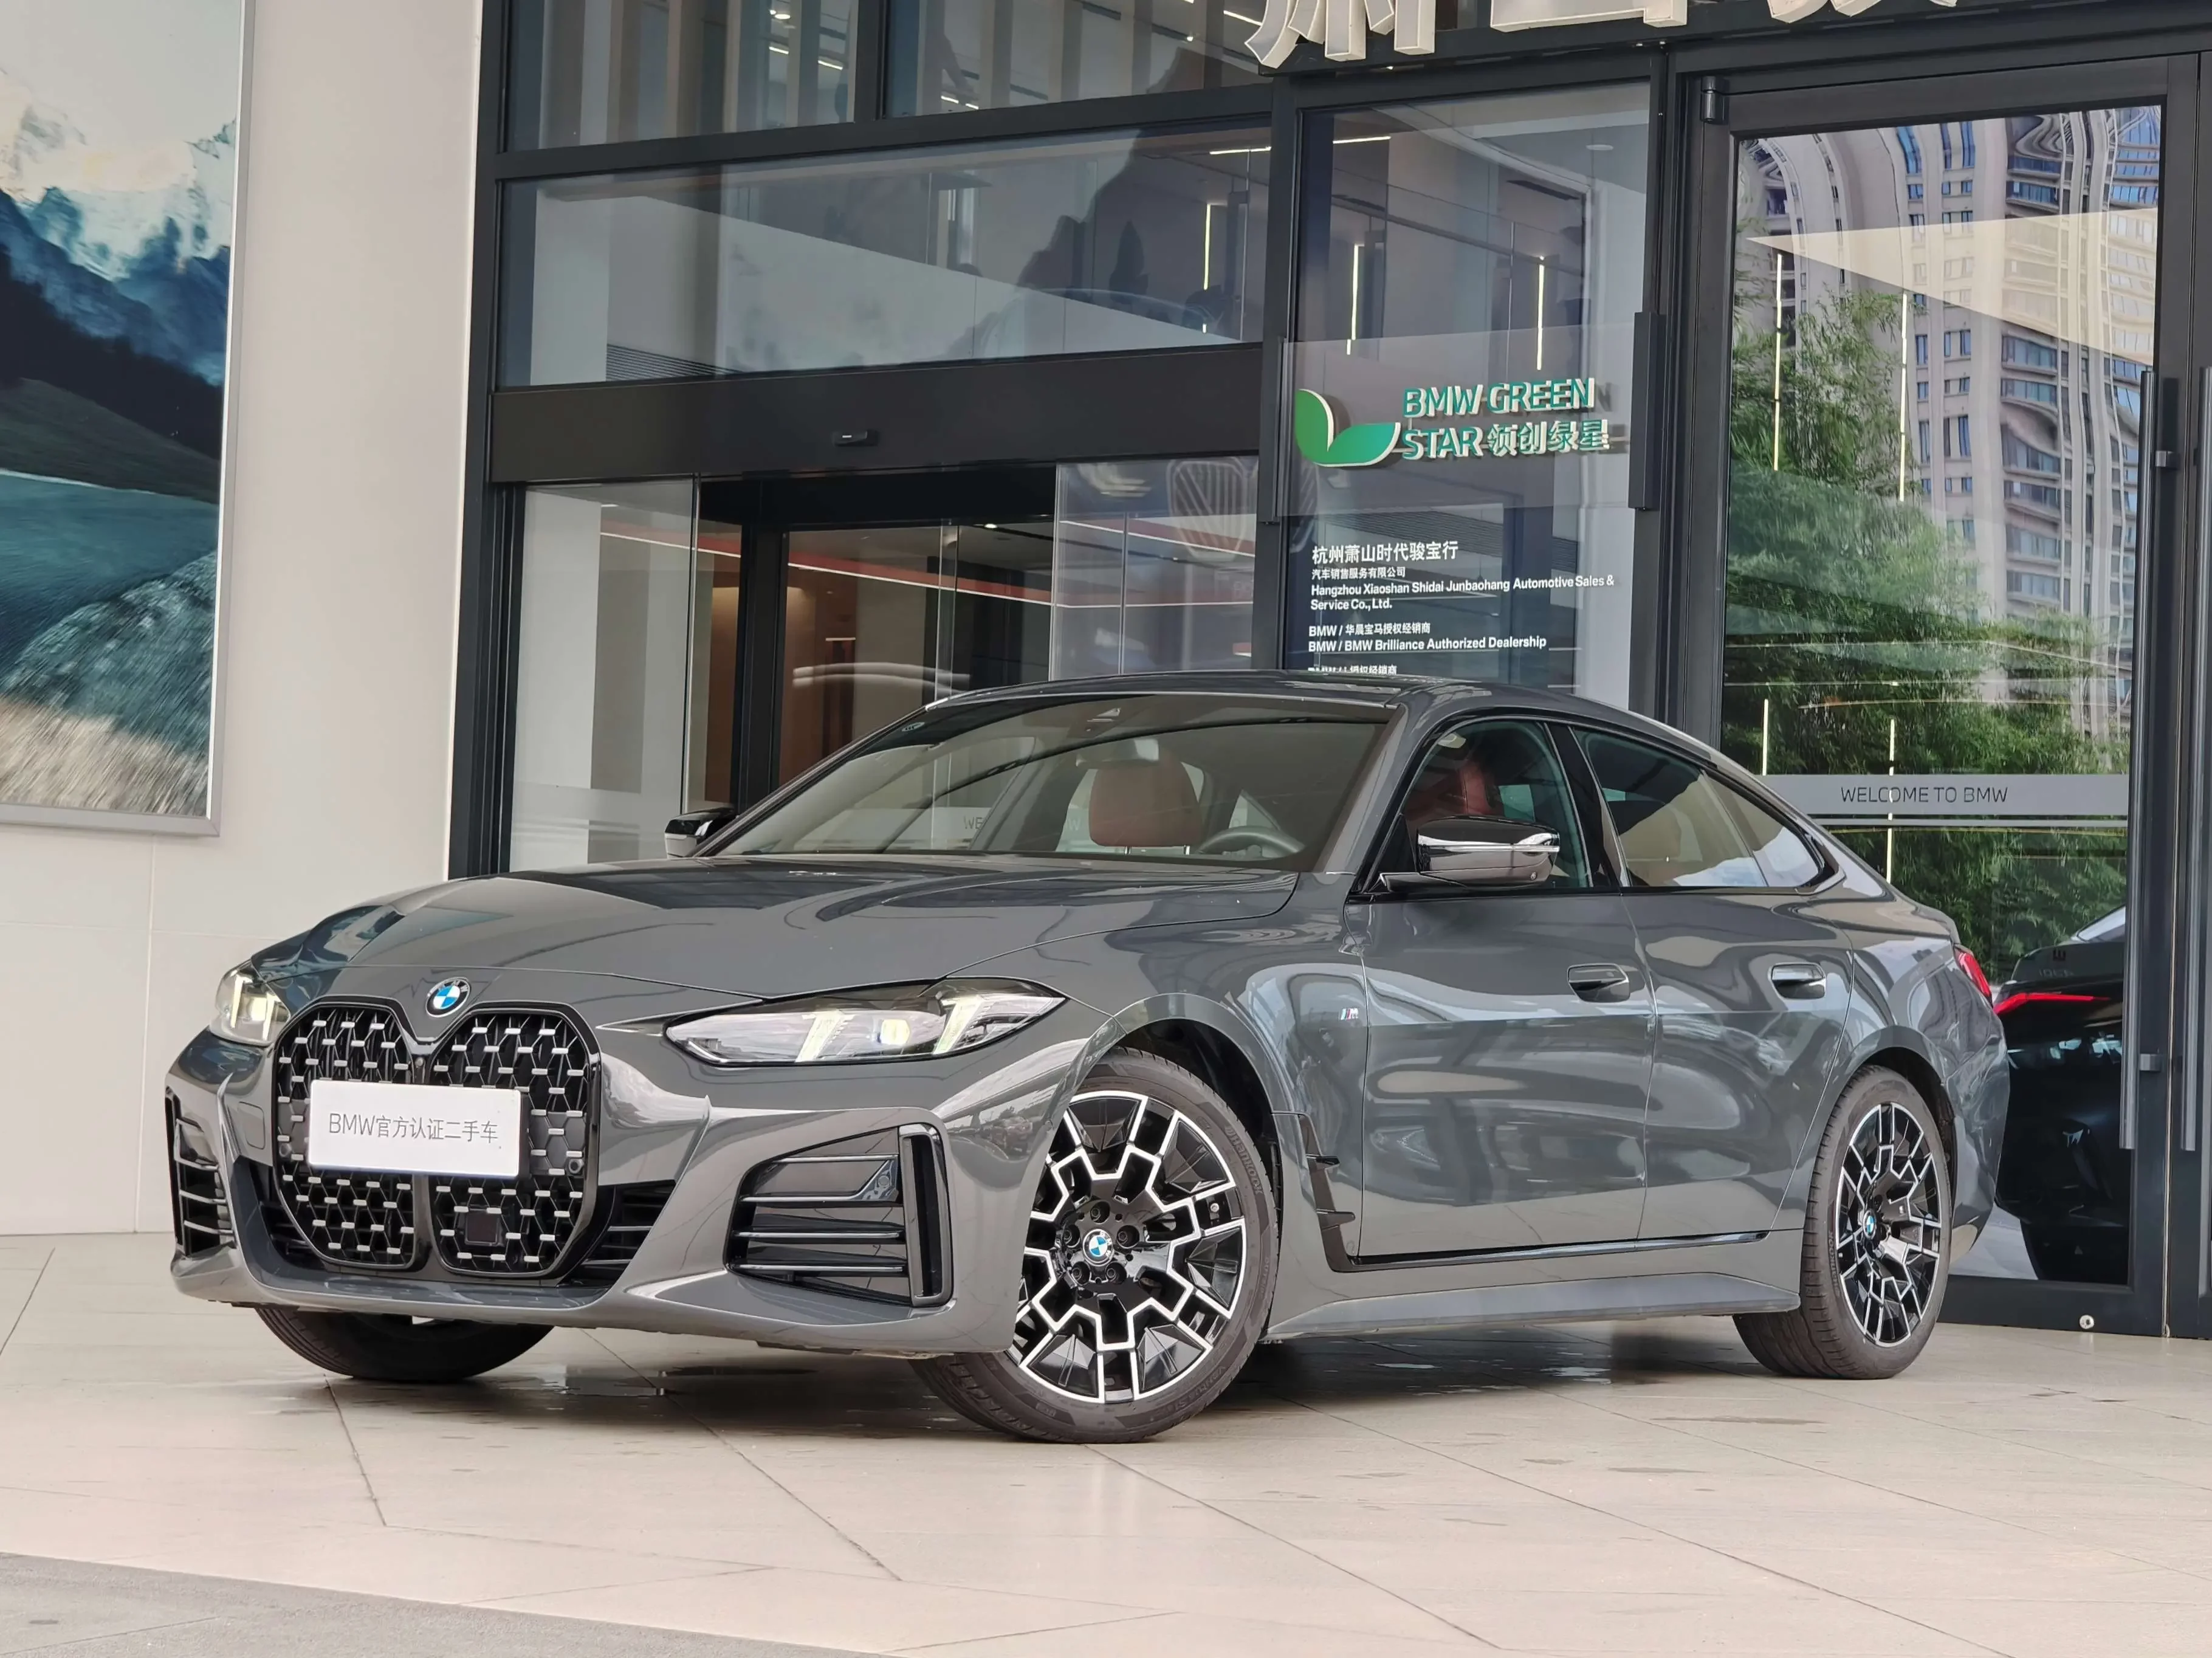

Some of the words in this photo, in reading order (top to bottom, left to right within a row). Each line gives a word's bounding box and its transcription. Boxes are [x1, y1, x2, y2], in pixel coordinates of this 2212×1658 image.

[1403, 384, 1483, 418] BMW
[1488, 377, 1595, 414] GREEN
[1403, 426, 1484, 460] STAR
[1487, 419, 1610, 458] 领创绿星
[1311, 540, 1458, 565] 杭州萧山时代骏宝行
[1311, 566, 1406, 580] 汽车销售服务有限公司
[1311, 584, 1361, 597] Hangzhou
[1363, 583, 1409, 594] Xiaoshan
[1412, 581, 1444, 593] Shidai
[1446, 579, 1510, 592] Junbaohang
[1513, 577, 1573, 589] Automotive
[1575, 575, 1604, 586] Sales
[1606, 574, 1615, 586] &
[1311, 599, 1349, 610] Service
[1308, 625, 1337, 636] BMW
[1345, 622, 1431, 635] 华晨宝马授权经销商
[1308, 641, 1337, 652] BMW
[1344, 640, 1373, 651] BMW
[1375, 639, 1424, 650] Brilliance
[1427, 637, 1486, 650] Authorized
[1488, 635, 1547, 649] Dealership
[1841, 786, 1929, 803] WELCOME
[1934, 786, 1957, 803] TO
[1963, 786, 2008, 803] BMW
[329, 1113, 498, 1143] BMW官方认证二手车
